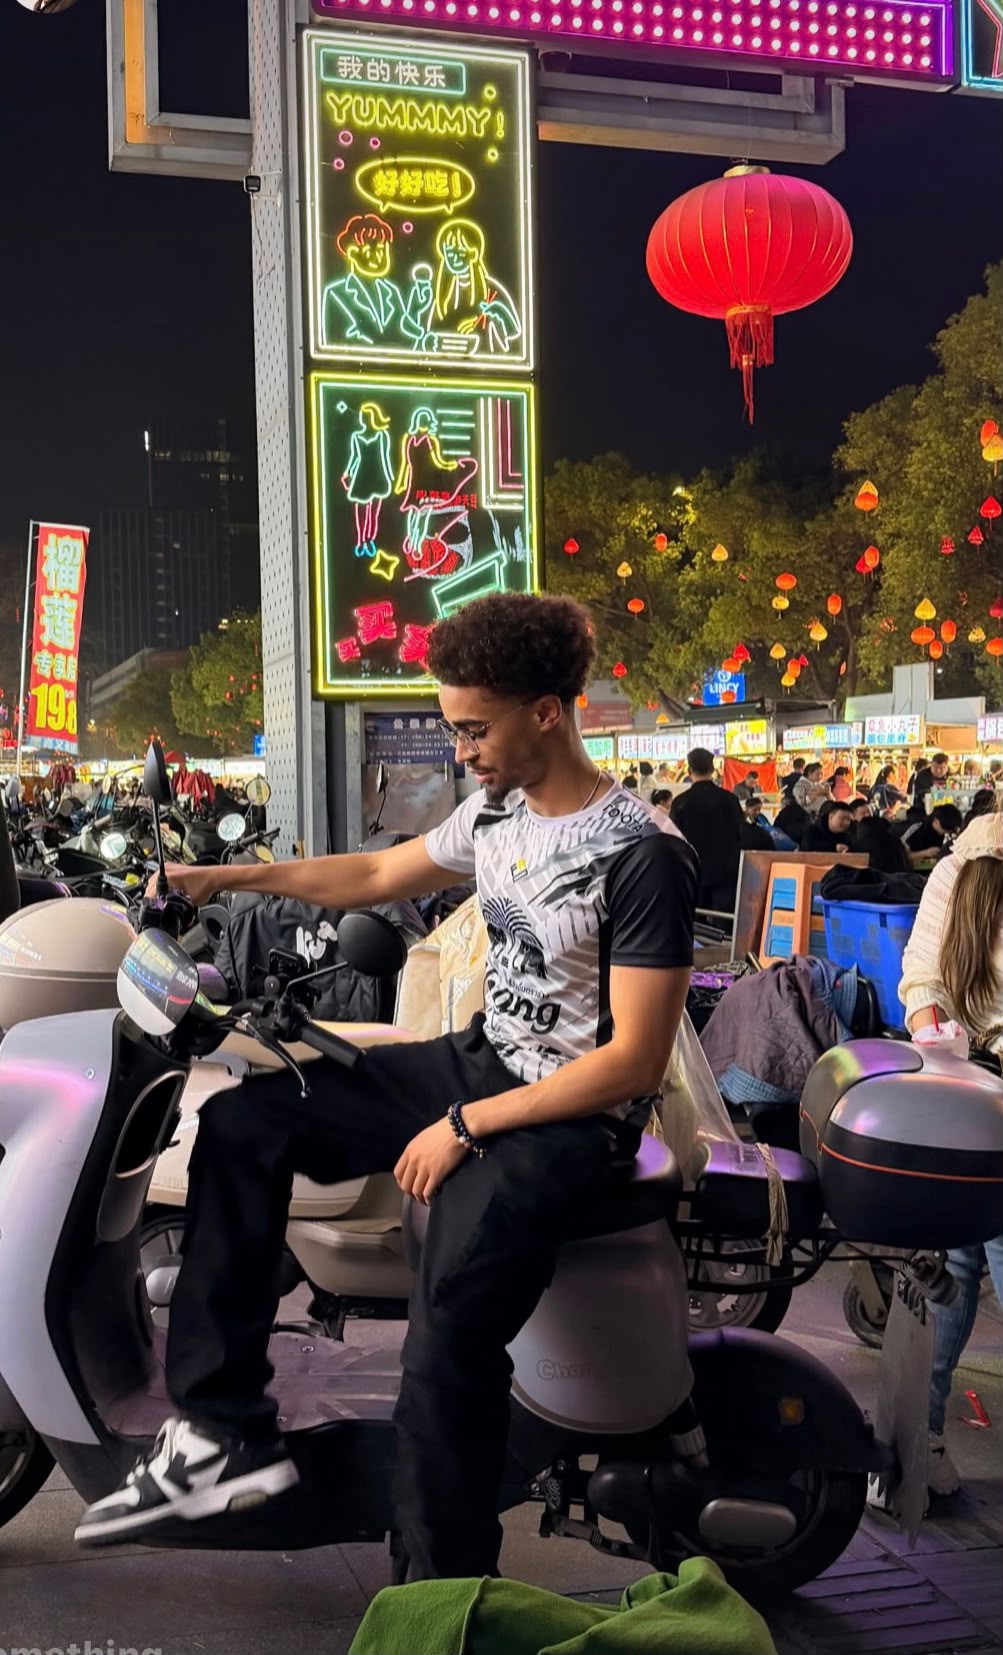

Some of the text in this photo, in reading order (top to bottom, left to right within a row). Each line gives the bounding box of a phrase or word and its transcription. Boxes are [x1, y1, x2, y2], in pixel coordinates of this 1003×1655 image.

[337, 55, 446, 88] 我的快乐
[40, 533, 84, 650] 榴莲
